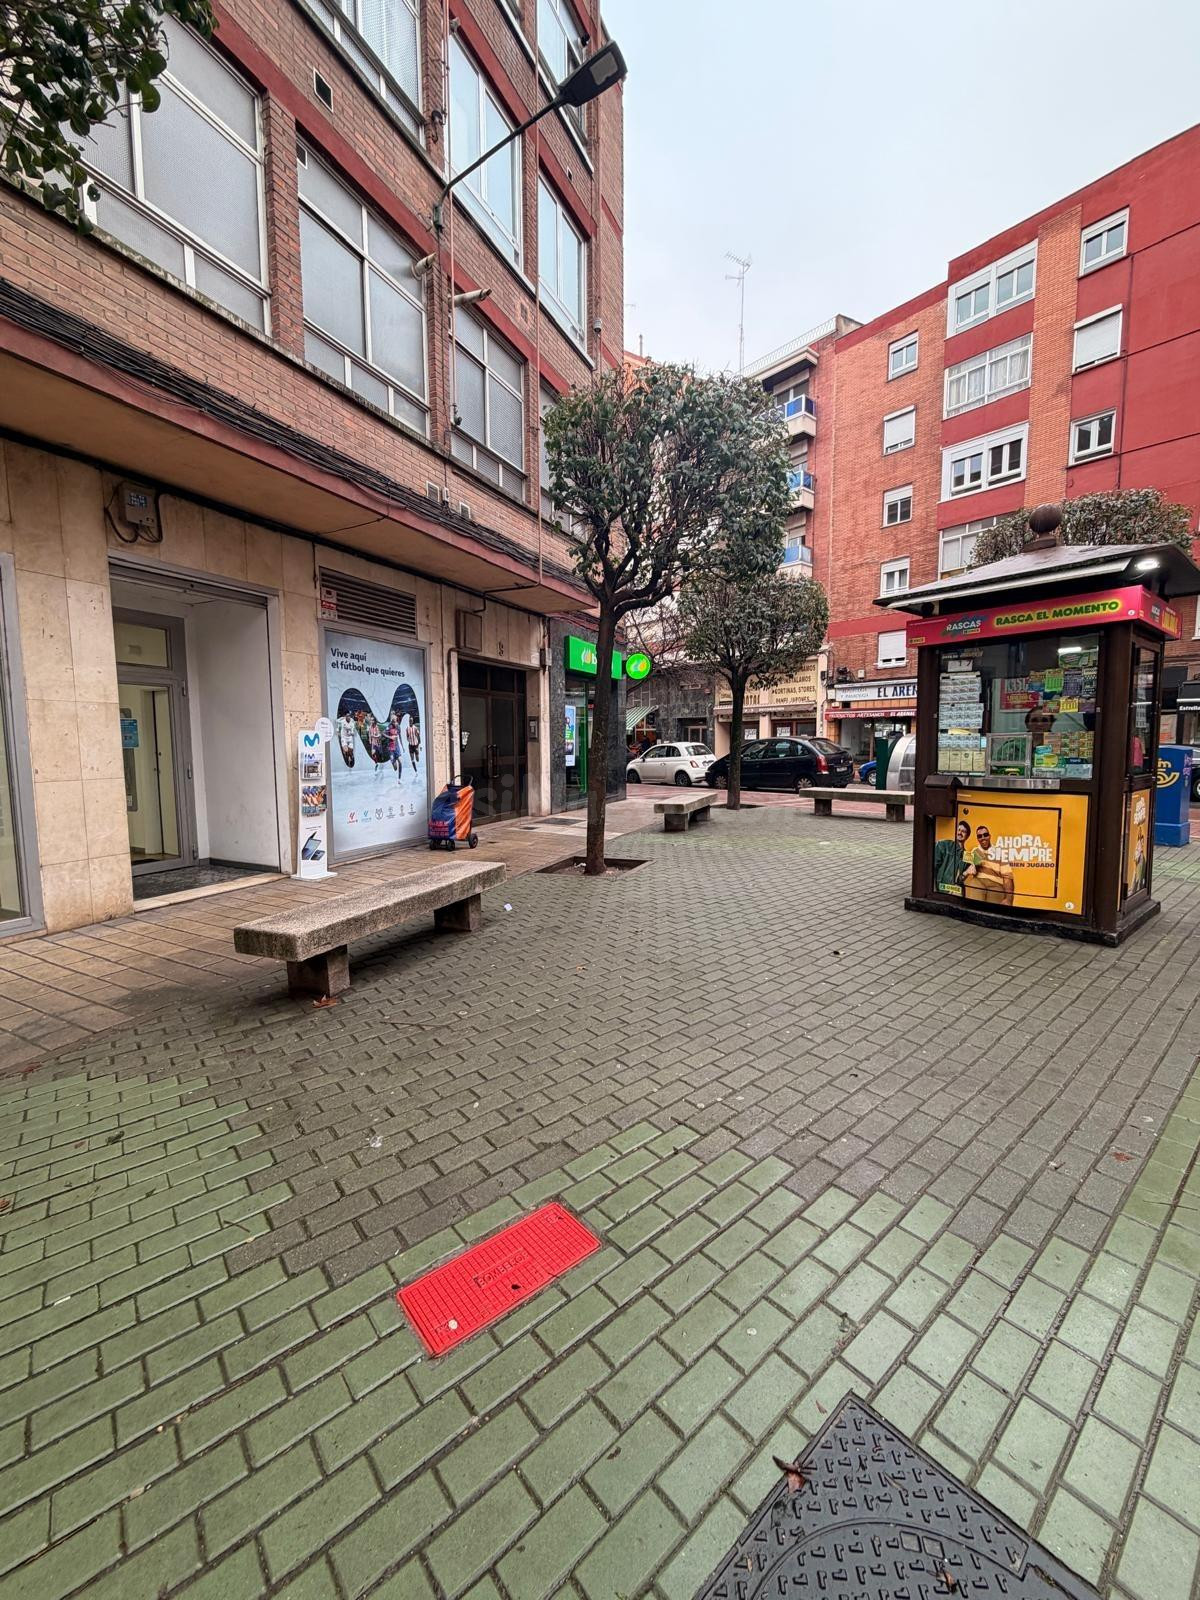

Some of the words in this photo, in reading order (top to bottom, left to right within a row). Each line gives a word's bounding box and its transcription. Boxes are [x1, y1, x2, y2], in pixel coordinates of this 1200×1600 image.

[995, 613, 1033, 626] RASCA
[1036, 611, 1049, 619] EL
[1052, 601, 1119, 618] MOMENTO
[946, 620, 981, 631] RASCAS
[330, 647, 349, 659] Vive
[331, 660, 339, 669] el
[340, 661, 364, 673] fútbol
[365, 666, 379, 675] que
[380, 667, 405, 677] quieres
[877, 687, 889, 698] EL
[996, 834, 1042, 848] AHORA
[987, 847, 1053, 863] SIEMPRE
